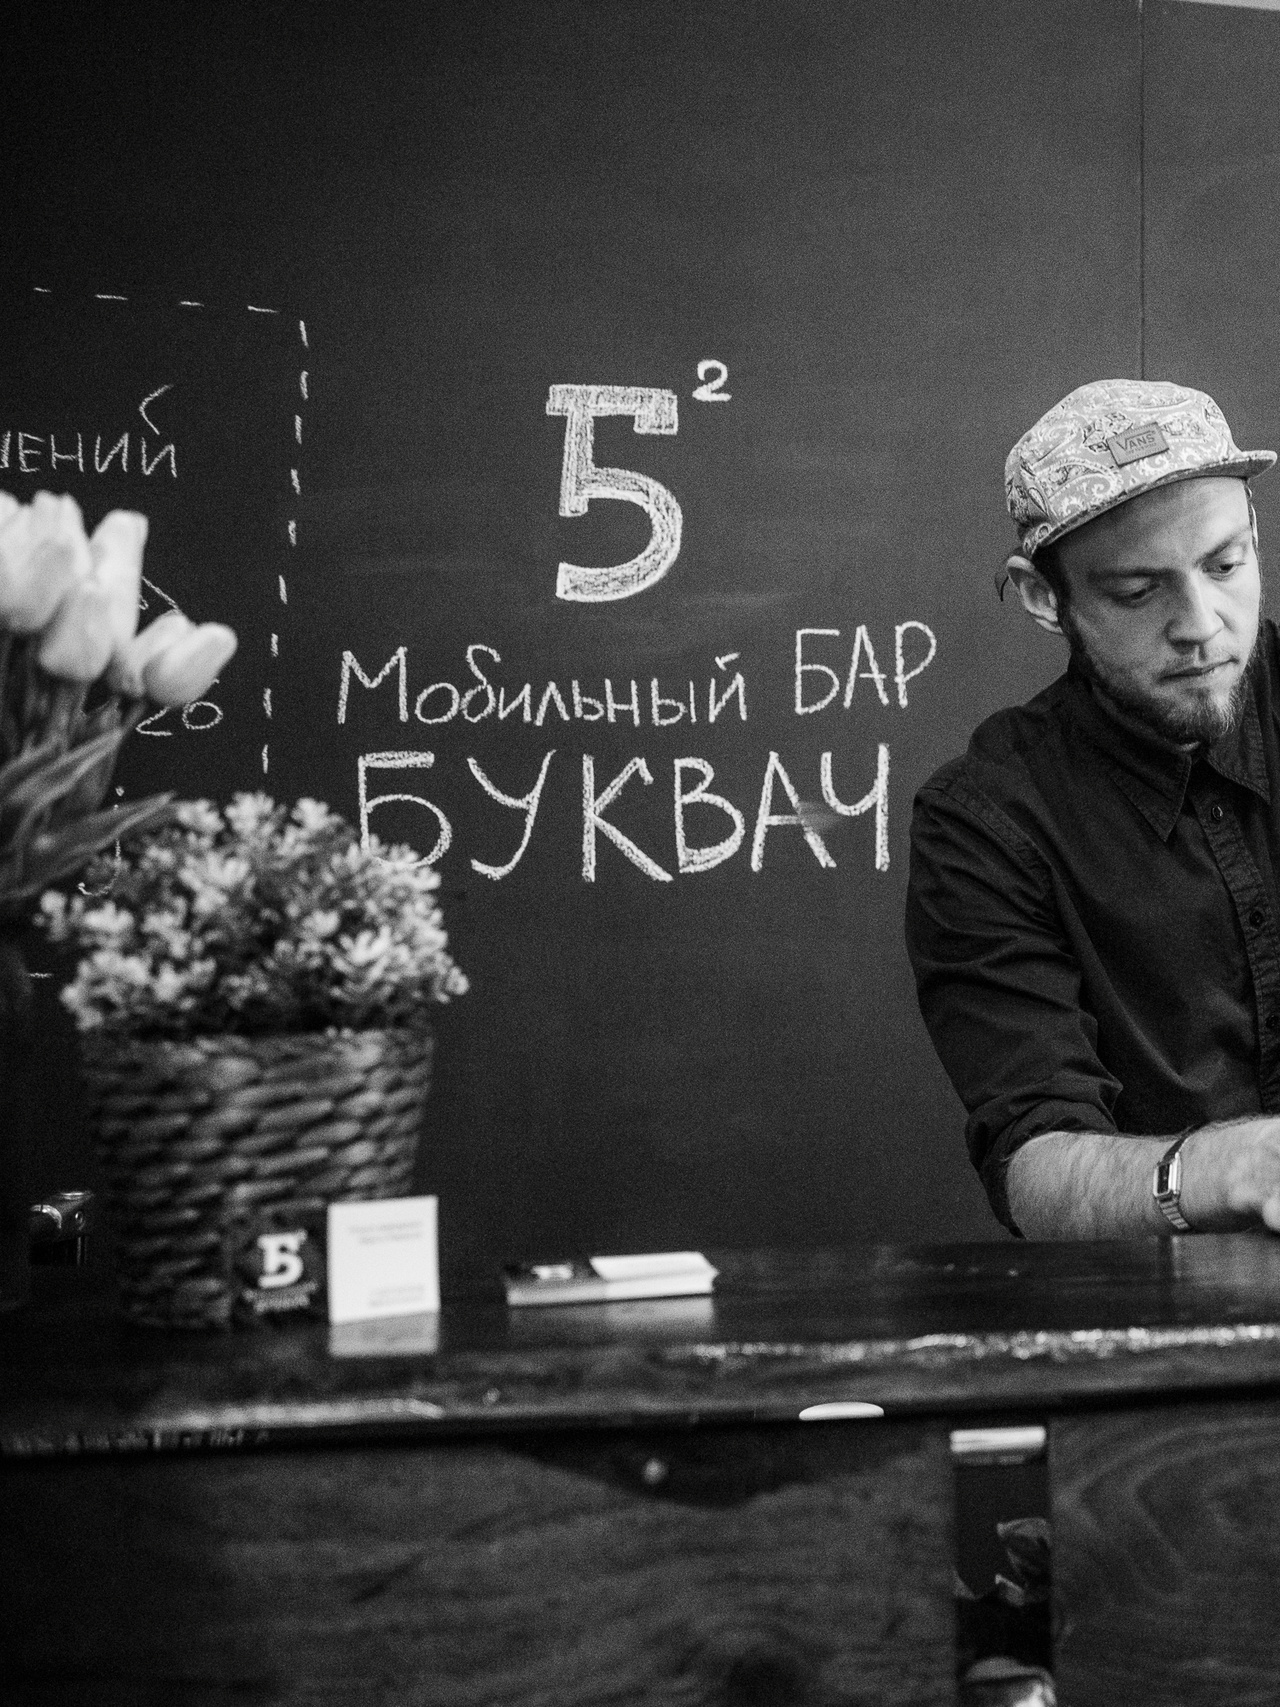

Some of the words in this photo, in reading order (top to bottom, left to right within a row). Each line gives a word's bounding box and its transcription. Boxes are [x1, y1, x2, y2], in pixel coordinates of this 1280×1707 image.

[1116, 430, 1156, 452] VANS
[337, 644, 747, 726] Мобильный
[794, 620, 938, 716] БАР
[357, 743, 892, 883] БУКВАЧ
